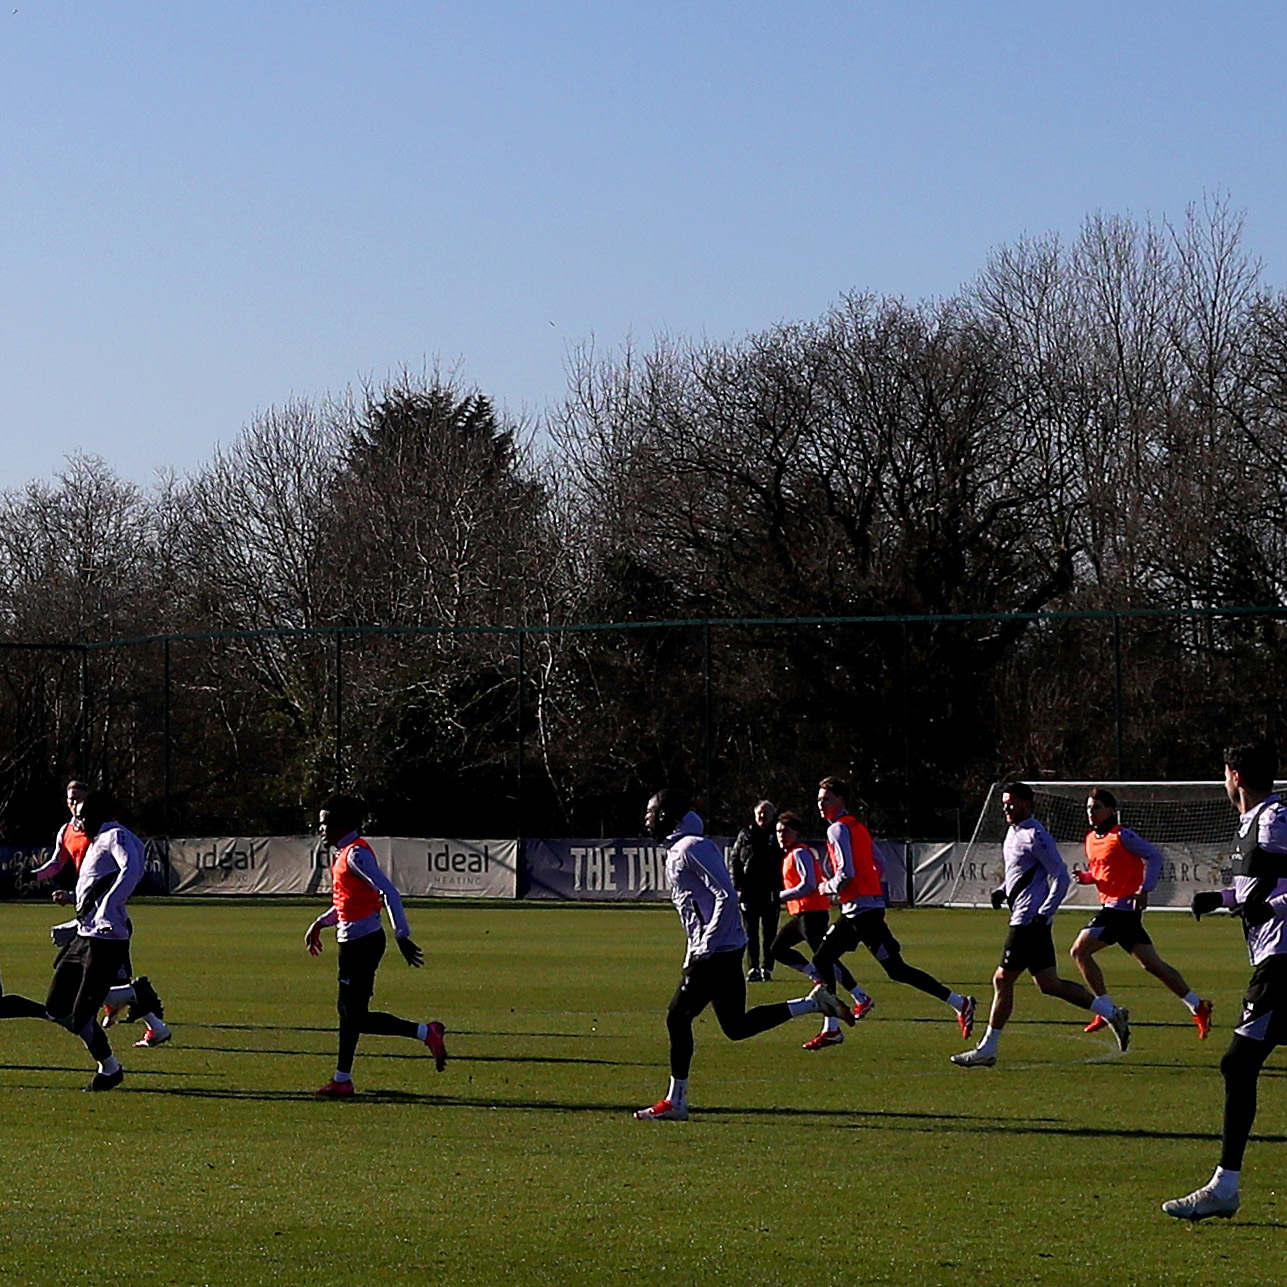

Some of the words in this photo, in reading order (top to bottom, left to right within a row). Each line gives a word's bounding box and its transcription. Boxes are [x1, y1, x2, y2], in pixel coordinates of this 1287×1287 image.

[195, 843, 255, 871] ideal
[427, 843, 489, 872] ideal
[569, 847, 617, 891] THE
[942, 863, 987, 881] MARC
[1158, 863, 1201, 882] ARC
[433, 876, 481, 886] HEATING
